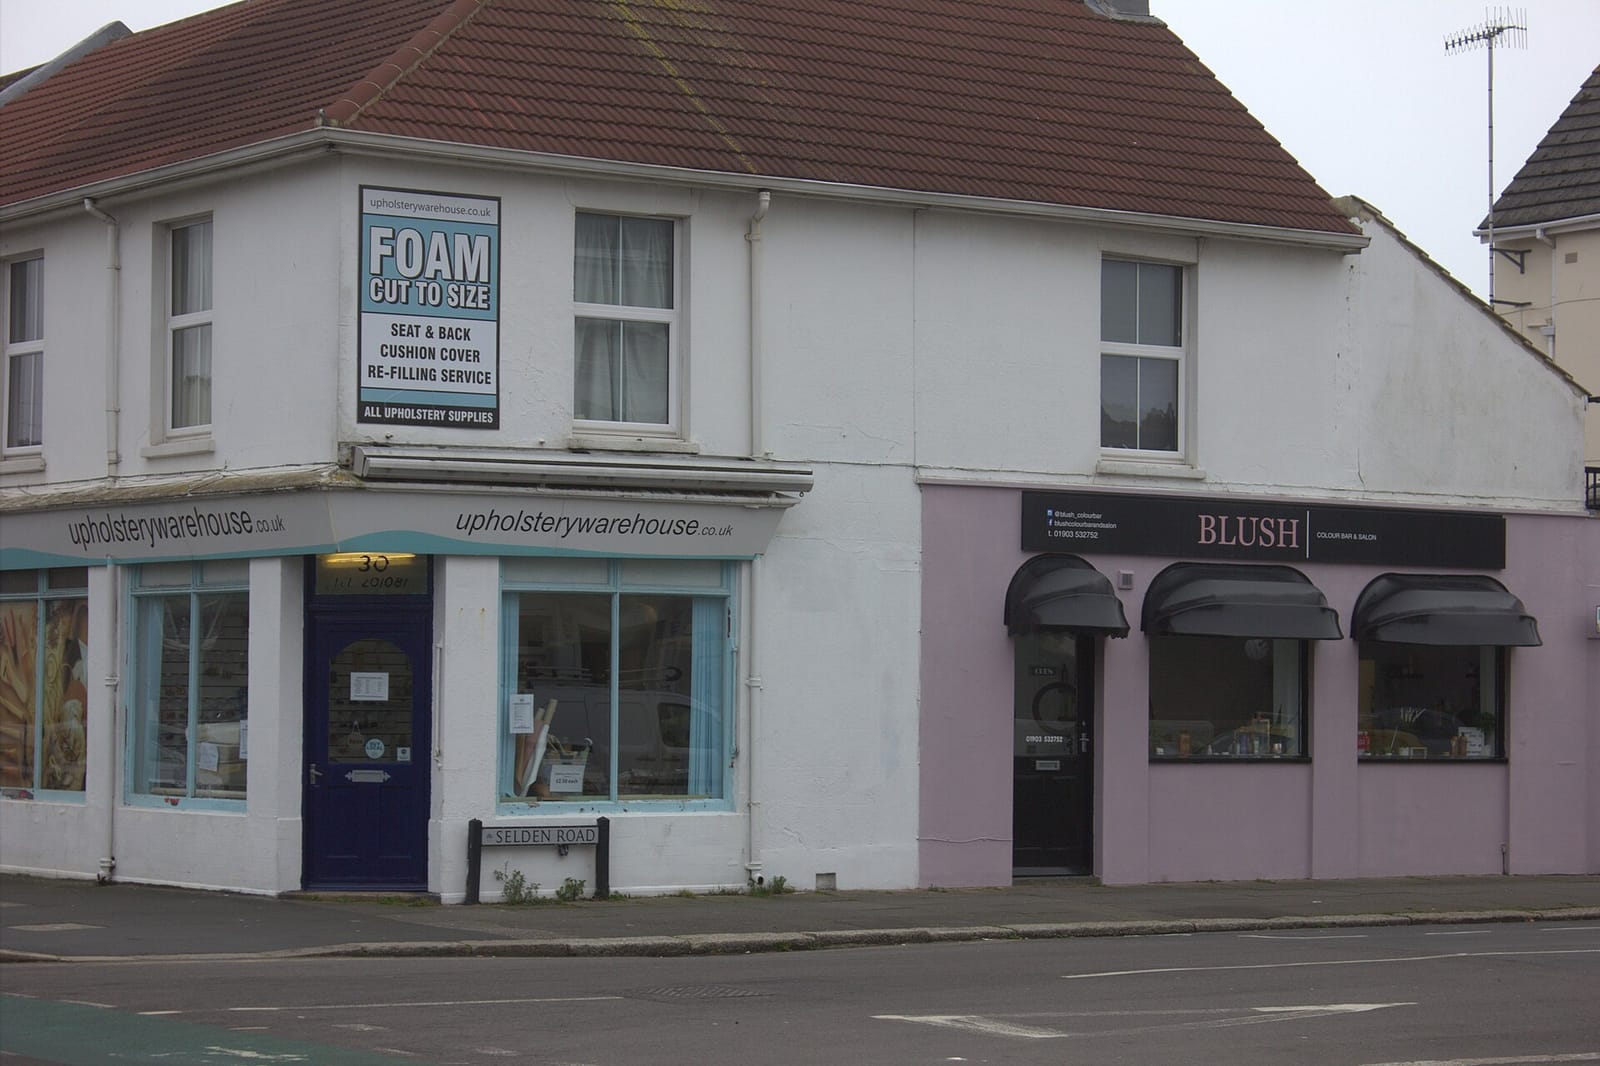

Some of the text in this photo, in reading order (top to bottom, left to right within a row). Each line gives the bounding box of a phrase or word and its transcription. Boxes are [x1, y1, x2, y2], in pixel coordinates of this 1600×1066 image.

[370, 198, 491, 218] upholsterywarehouse.co.uk
[369, 226, 491, 284] FOAM
[369, 277, 491, 310] CUT TO SIZE
[391, 323, 471, 341] SEAT & BACK
[380, 343, 480, 363] CUSHION COVER
[368, 364, 492, 385] RE-FILLING SERVICE
[364, 406, 493, 424] ALL UPHOLSTERY SUPPLIES
[68, 506, 286, 551] upholsterywarehouse.co.uk
[455, 509, 733, 538] upholsterywarehouse.co.uk
[1197, 513, 1300, 548] BLUSH
[1053, 530, 1074, 538] 01903
[1075, 531, 1099, 539] 532752
[358, 555, 390, 573] 30
[496, 828, 595, 844] SELDEN ROAD
